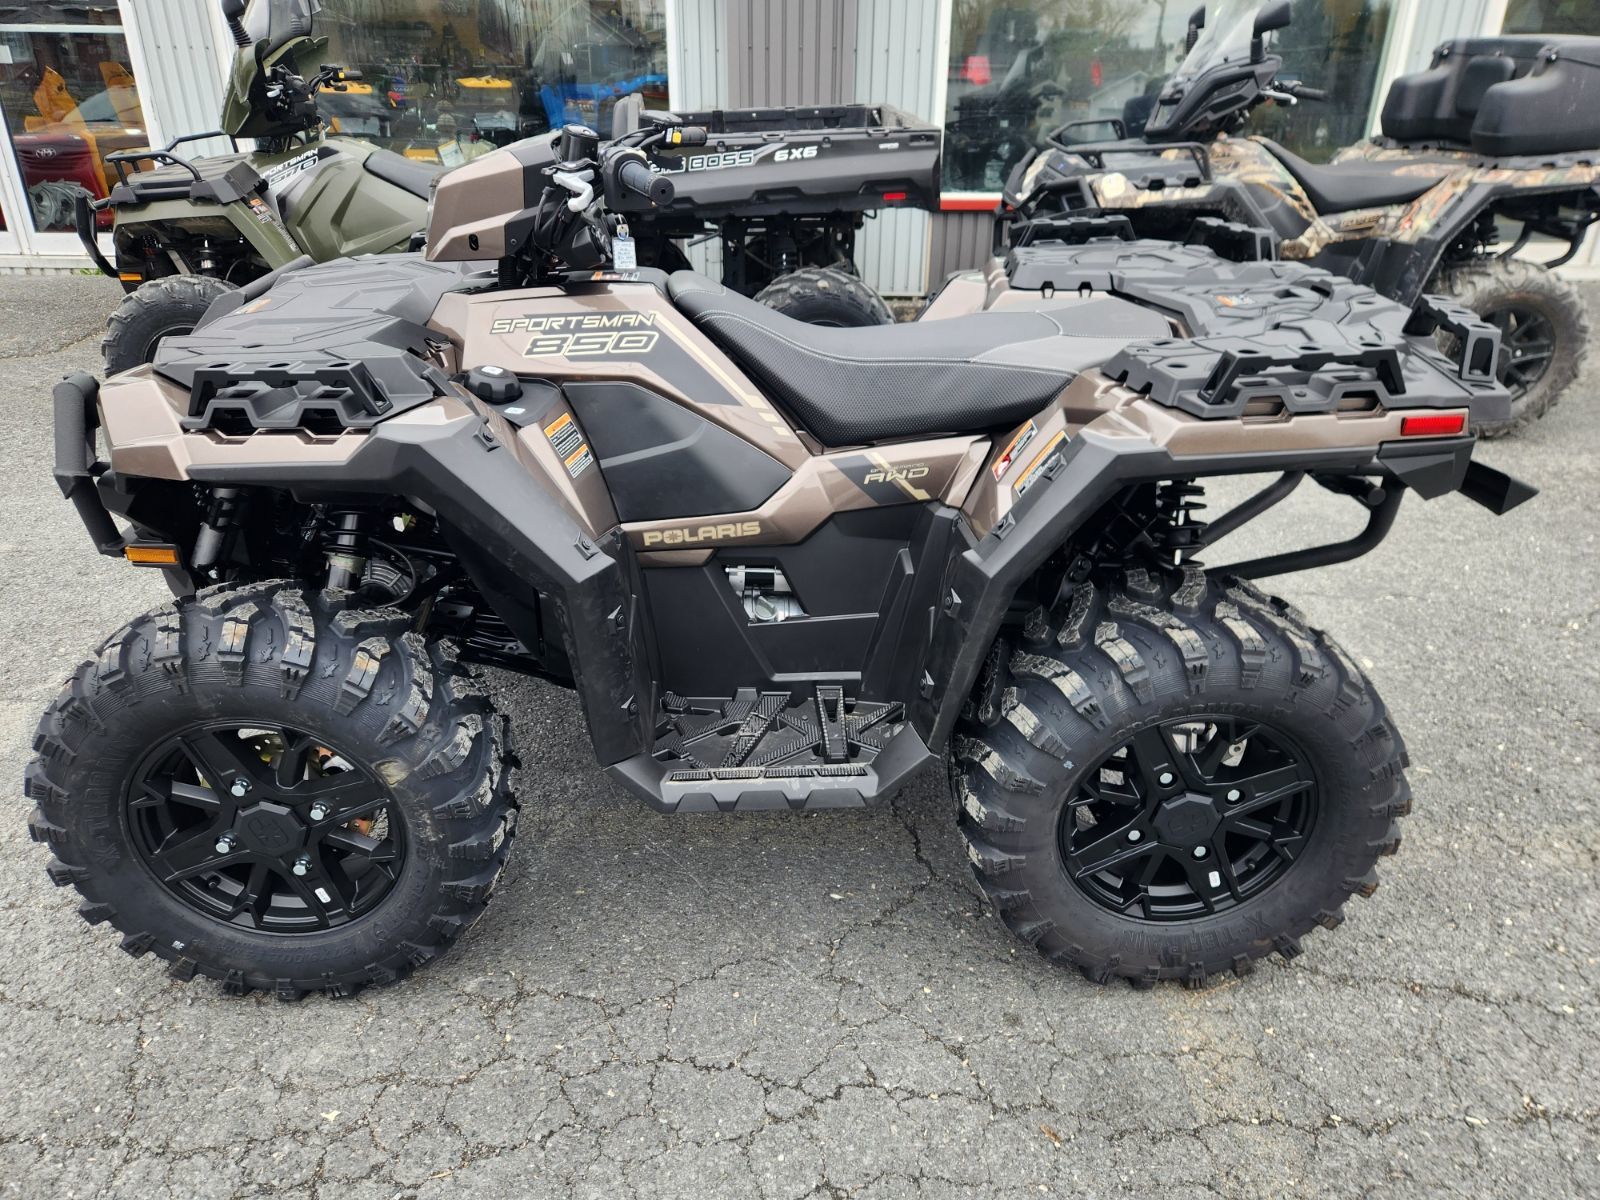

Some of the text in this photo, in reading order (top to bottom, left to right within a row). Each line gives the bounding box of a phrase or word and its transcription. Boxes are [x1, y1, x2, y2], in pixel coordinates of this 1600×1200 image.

[261, 148, 318, 180] PORTSMAN
[689, 150, 754, 172] BOSS
[774, 145, 818, 162] 6X6
[490, 312, 656, 334] SPORTSMAN
[522, 331, 660, 358] 850
[863, 466, 930, 485] AWD
[642, 520, 761, 546] POLARIS
